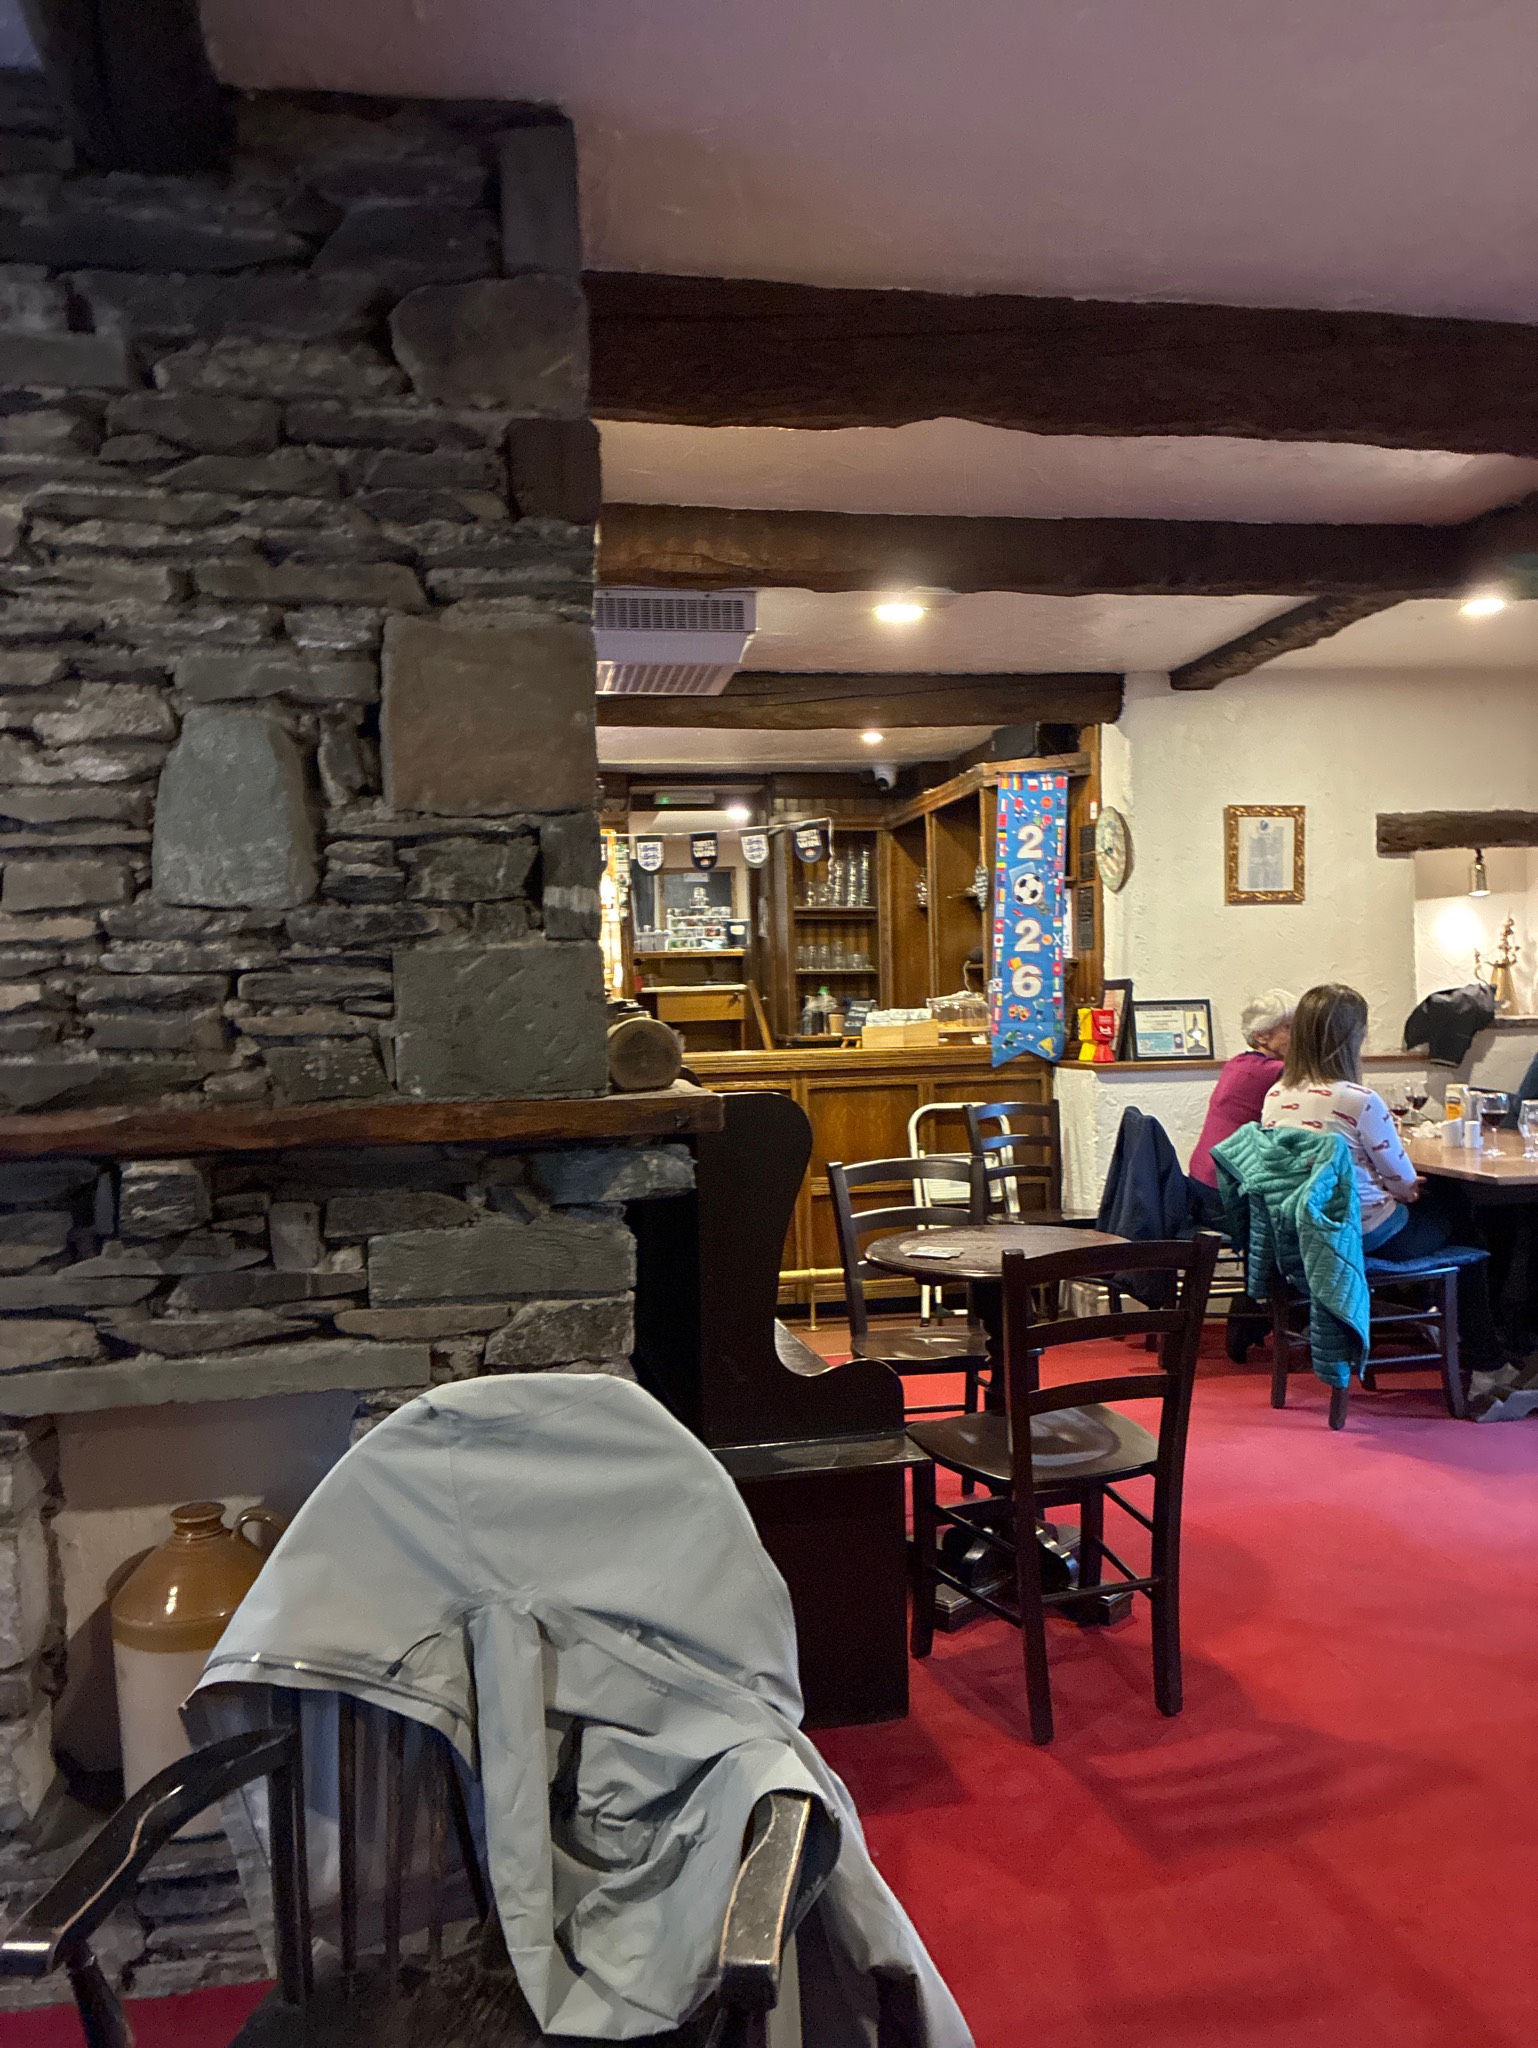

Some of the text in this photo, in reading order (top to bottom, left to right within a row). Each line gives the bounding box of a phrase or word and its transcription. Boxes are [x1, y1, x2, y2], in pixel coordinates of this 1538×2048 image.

[1012, 825, 1043, 998] 2 2 6
